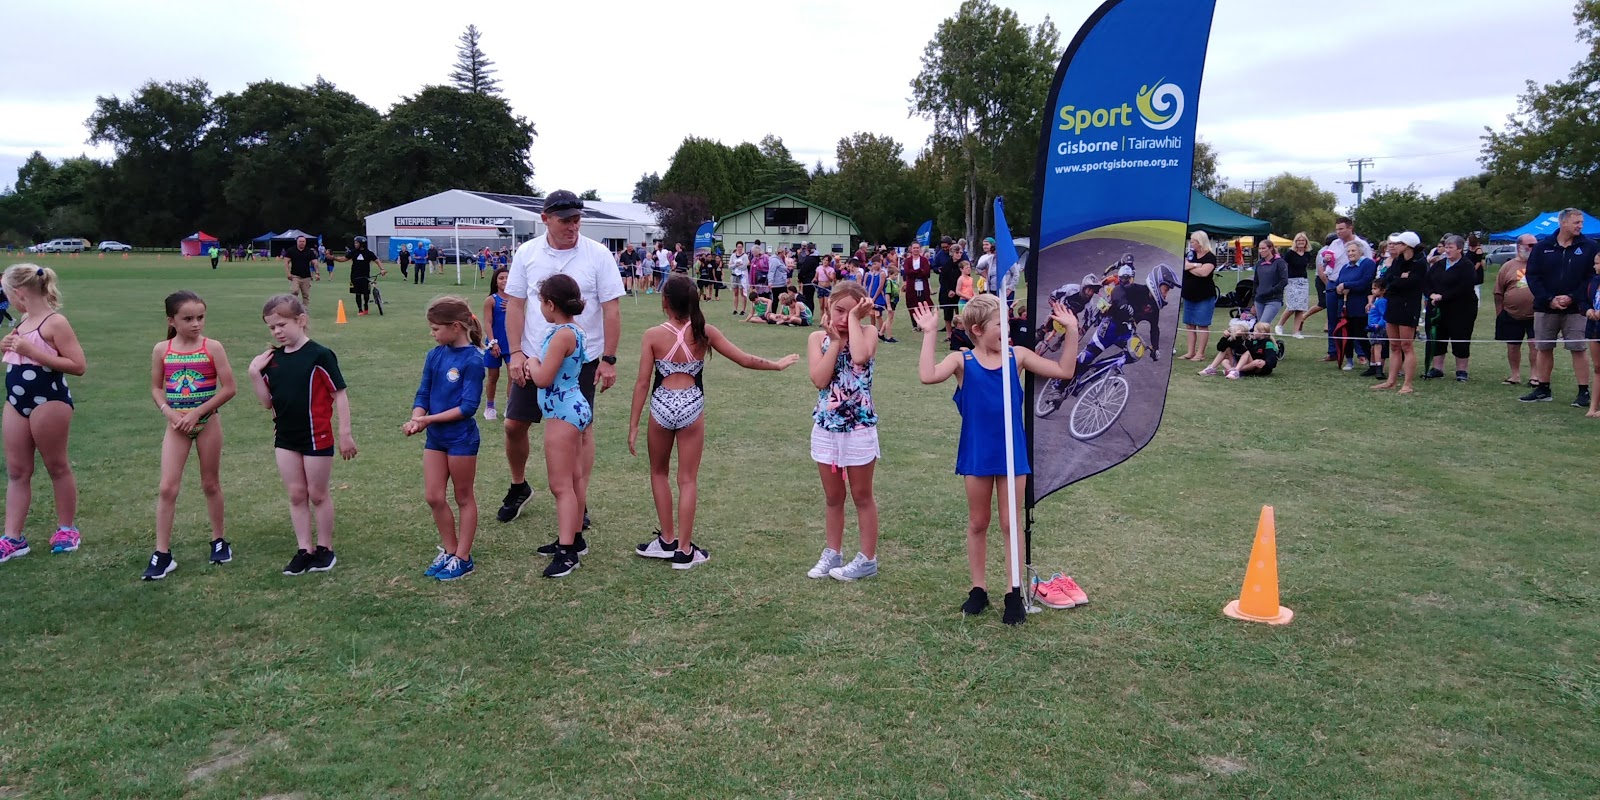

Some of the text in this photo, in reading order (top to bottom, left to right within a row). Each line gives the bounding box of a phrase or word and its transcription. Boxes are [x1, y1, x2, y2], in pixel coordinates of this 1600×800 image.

[1059, 103, 1132, 135] Sport
[1057, 135, 1182, 155] Gisborne Tairawhiti
[1055, 157, 1179, 174] www.sportgisborne.org.nz
[396, 217, 435, 226] ENTERPRISE
[456, 217, 483, 226] AQUATIC
